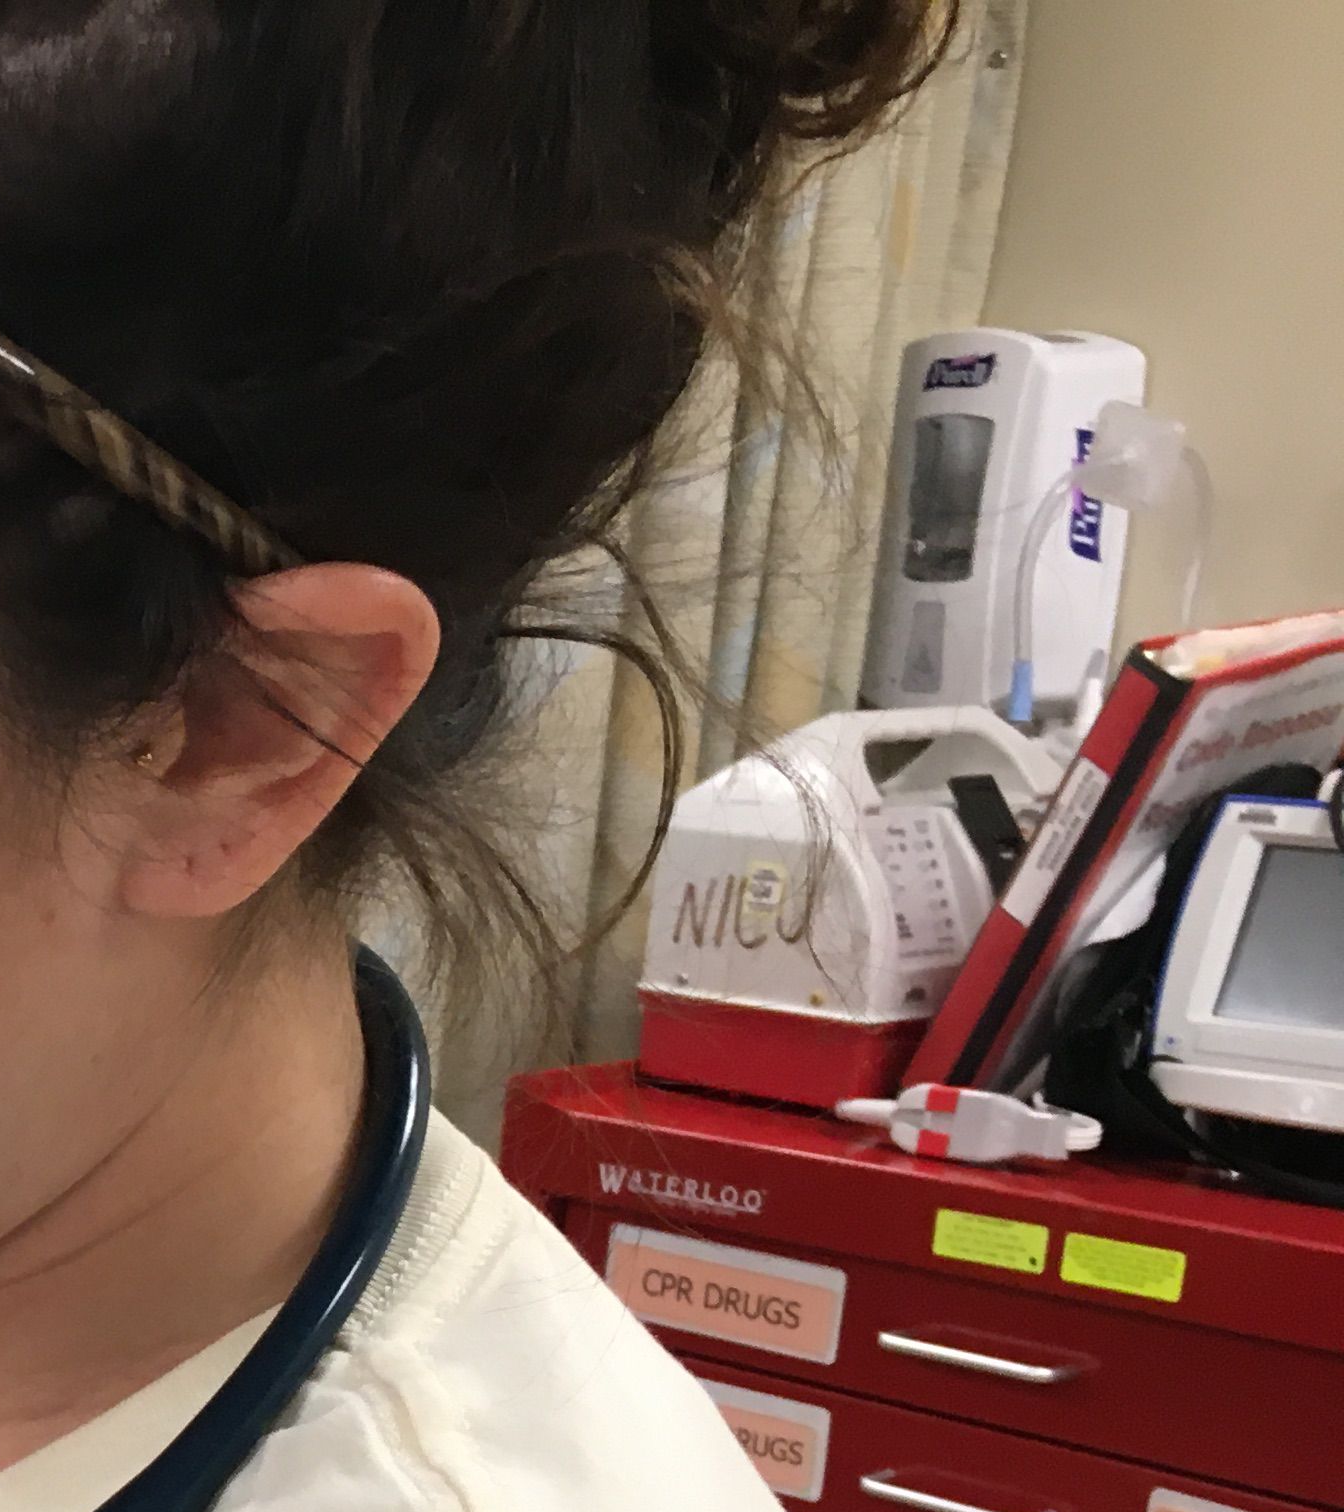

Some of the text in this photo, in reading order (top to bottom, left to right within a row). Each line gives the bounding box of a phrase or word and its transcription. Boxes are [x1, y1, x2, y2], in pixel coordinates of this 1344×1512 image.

[673, 872, 814, 950] NICU
[599, 1162, 762, 1215] WATERLOO
[642, 1268, 802, 1331] CPR DRUGS
[734, 1426, 804, 1466] RUGS
